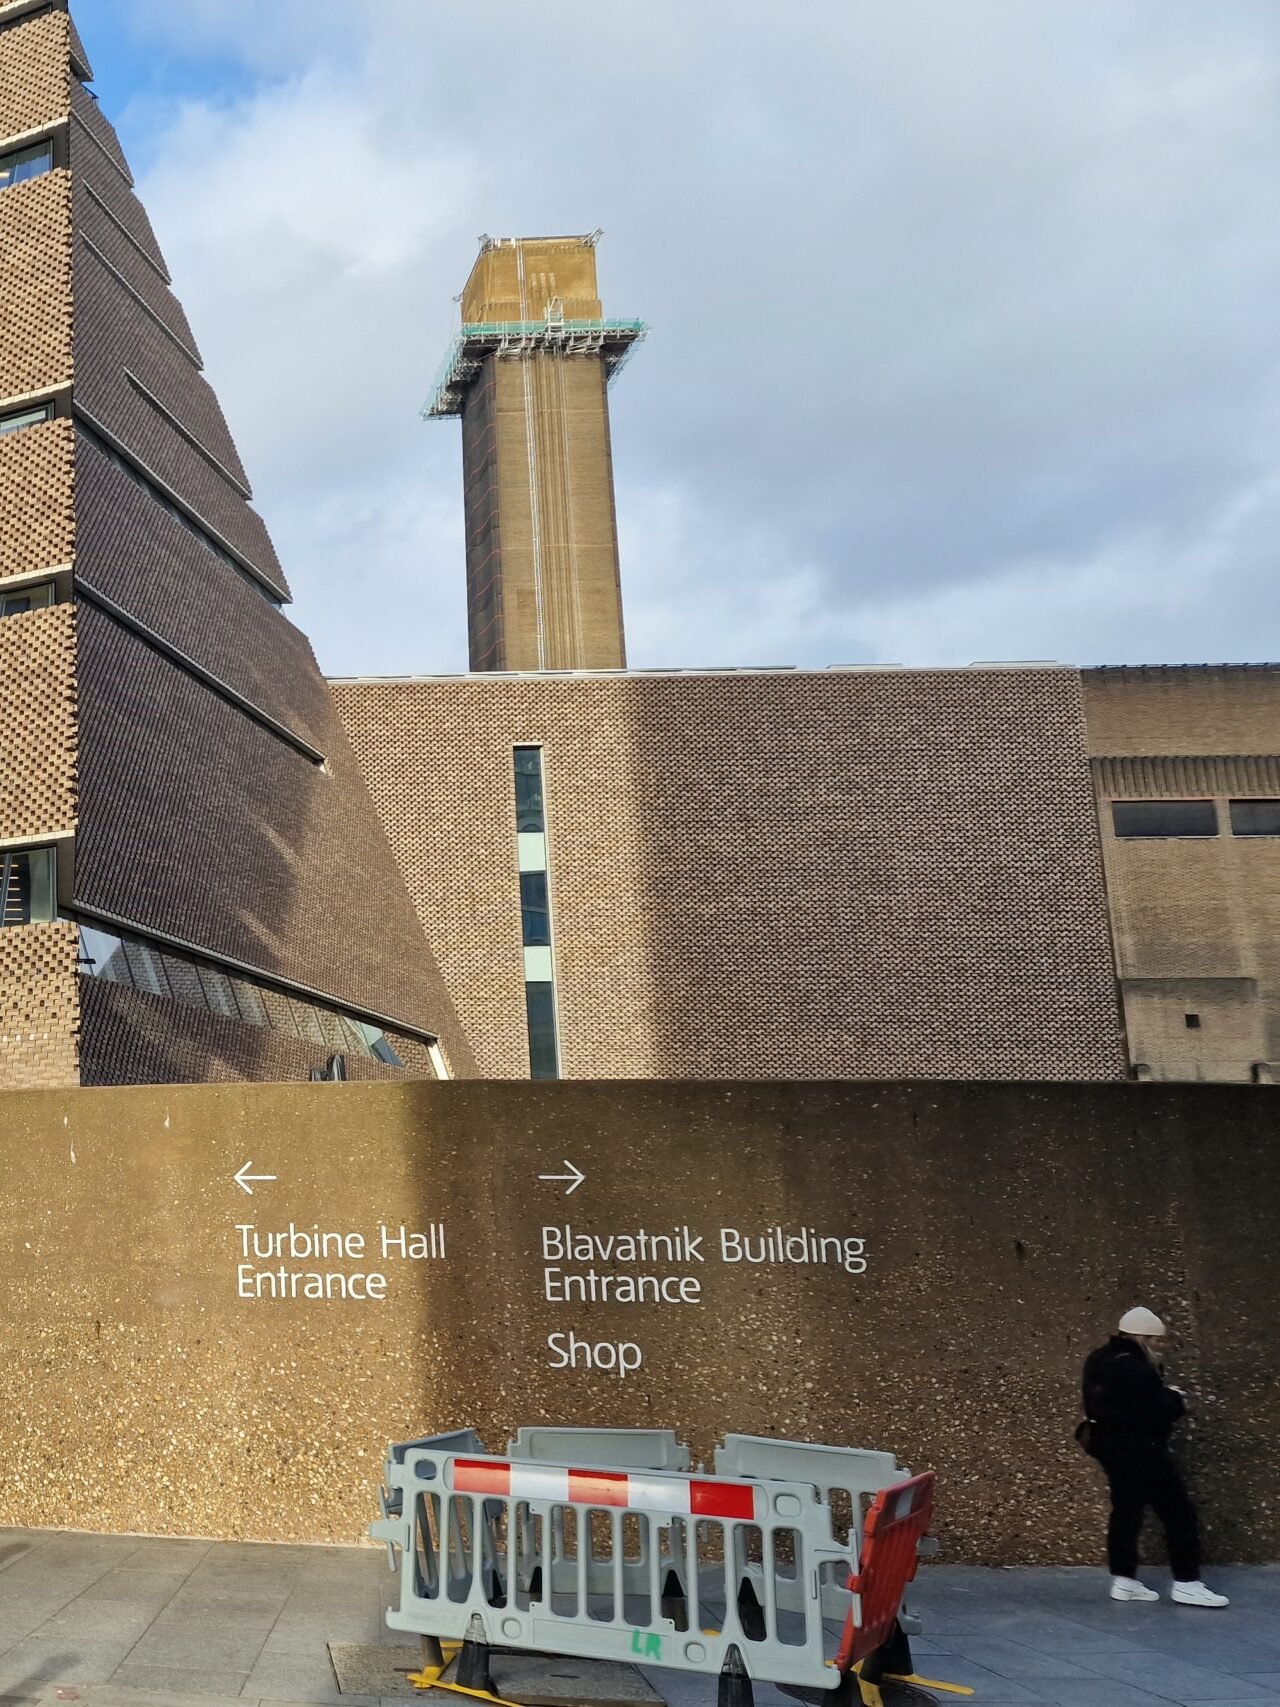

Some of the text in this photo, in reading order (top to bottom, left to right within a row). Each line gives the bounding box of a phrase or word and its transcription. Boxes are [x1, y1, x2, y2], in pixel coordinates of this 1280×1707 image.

[234, 1222, 447, 1260] Turbine Hall
[541, 1224, 868, 1274] Blavatnik Building
[237, 1263, 388, 1301] Entrance
[543, 1266, 702, 1304] Entrance
[546, 1330, 643, 1379] Shop
[631, 1627, 661, 1660] LR
